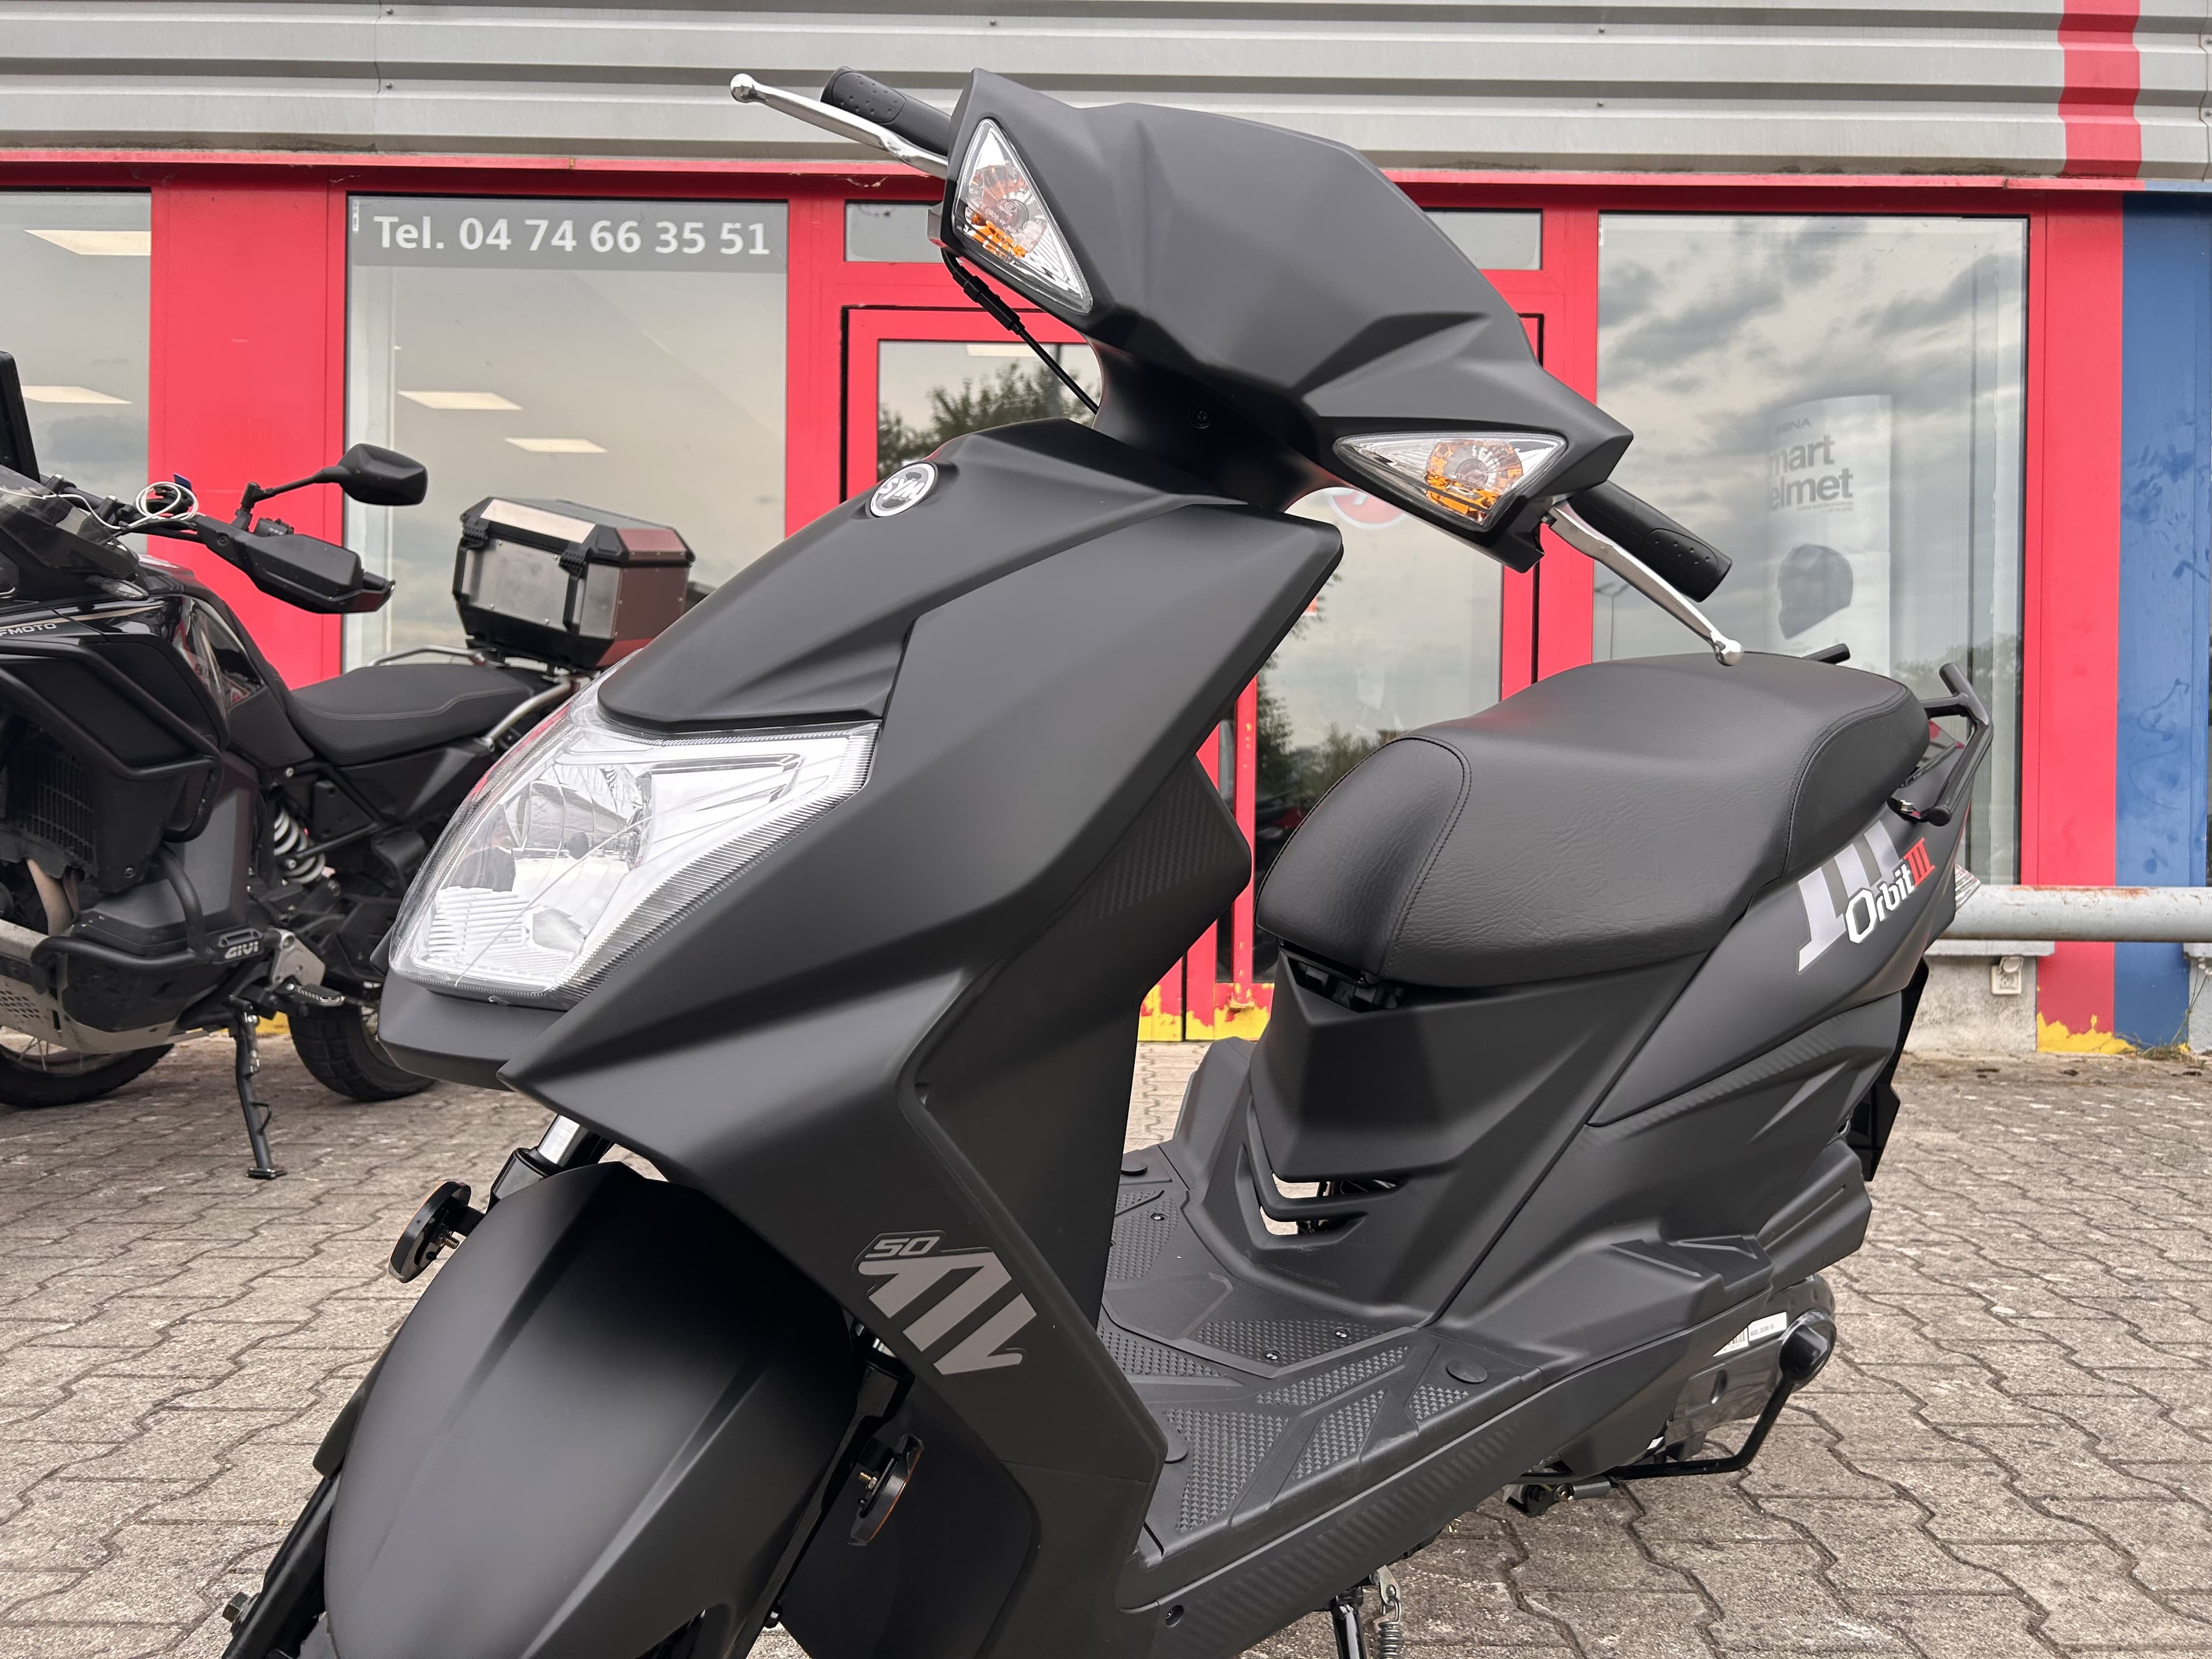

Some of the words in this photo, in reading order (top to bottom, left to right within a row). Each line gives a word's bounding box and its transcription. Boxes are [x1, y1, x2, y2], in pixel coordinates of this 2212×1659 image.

[373, 215, 445, 249] Tel.
[459, 217, 512, 250] 04
[524, 219, 577, 252] 74
[589, 220, 642, 253] 66
[654, 221, 706, 254] 35
[719, 222, 770, 255] 51
[1770, 434, 1835, 476] mart
[878, 478, 925, 500] SYM
[1769, 467, 1853, 511] elmet
[1845, 863, 1915, 944] Orbit
[864, 1236, 941, 1258] 50
